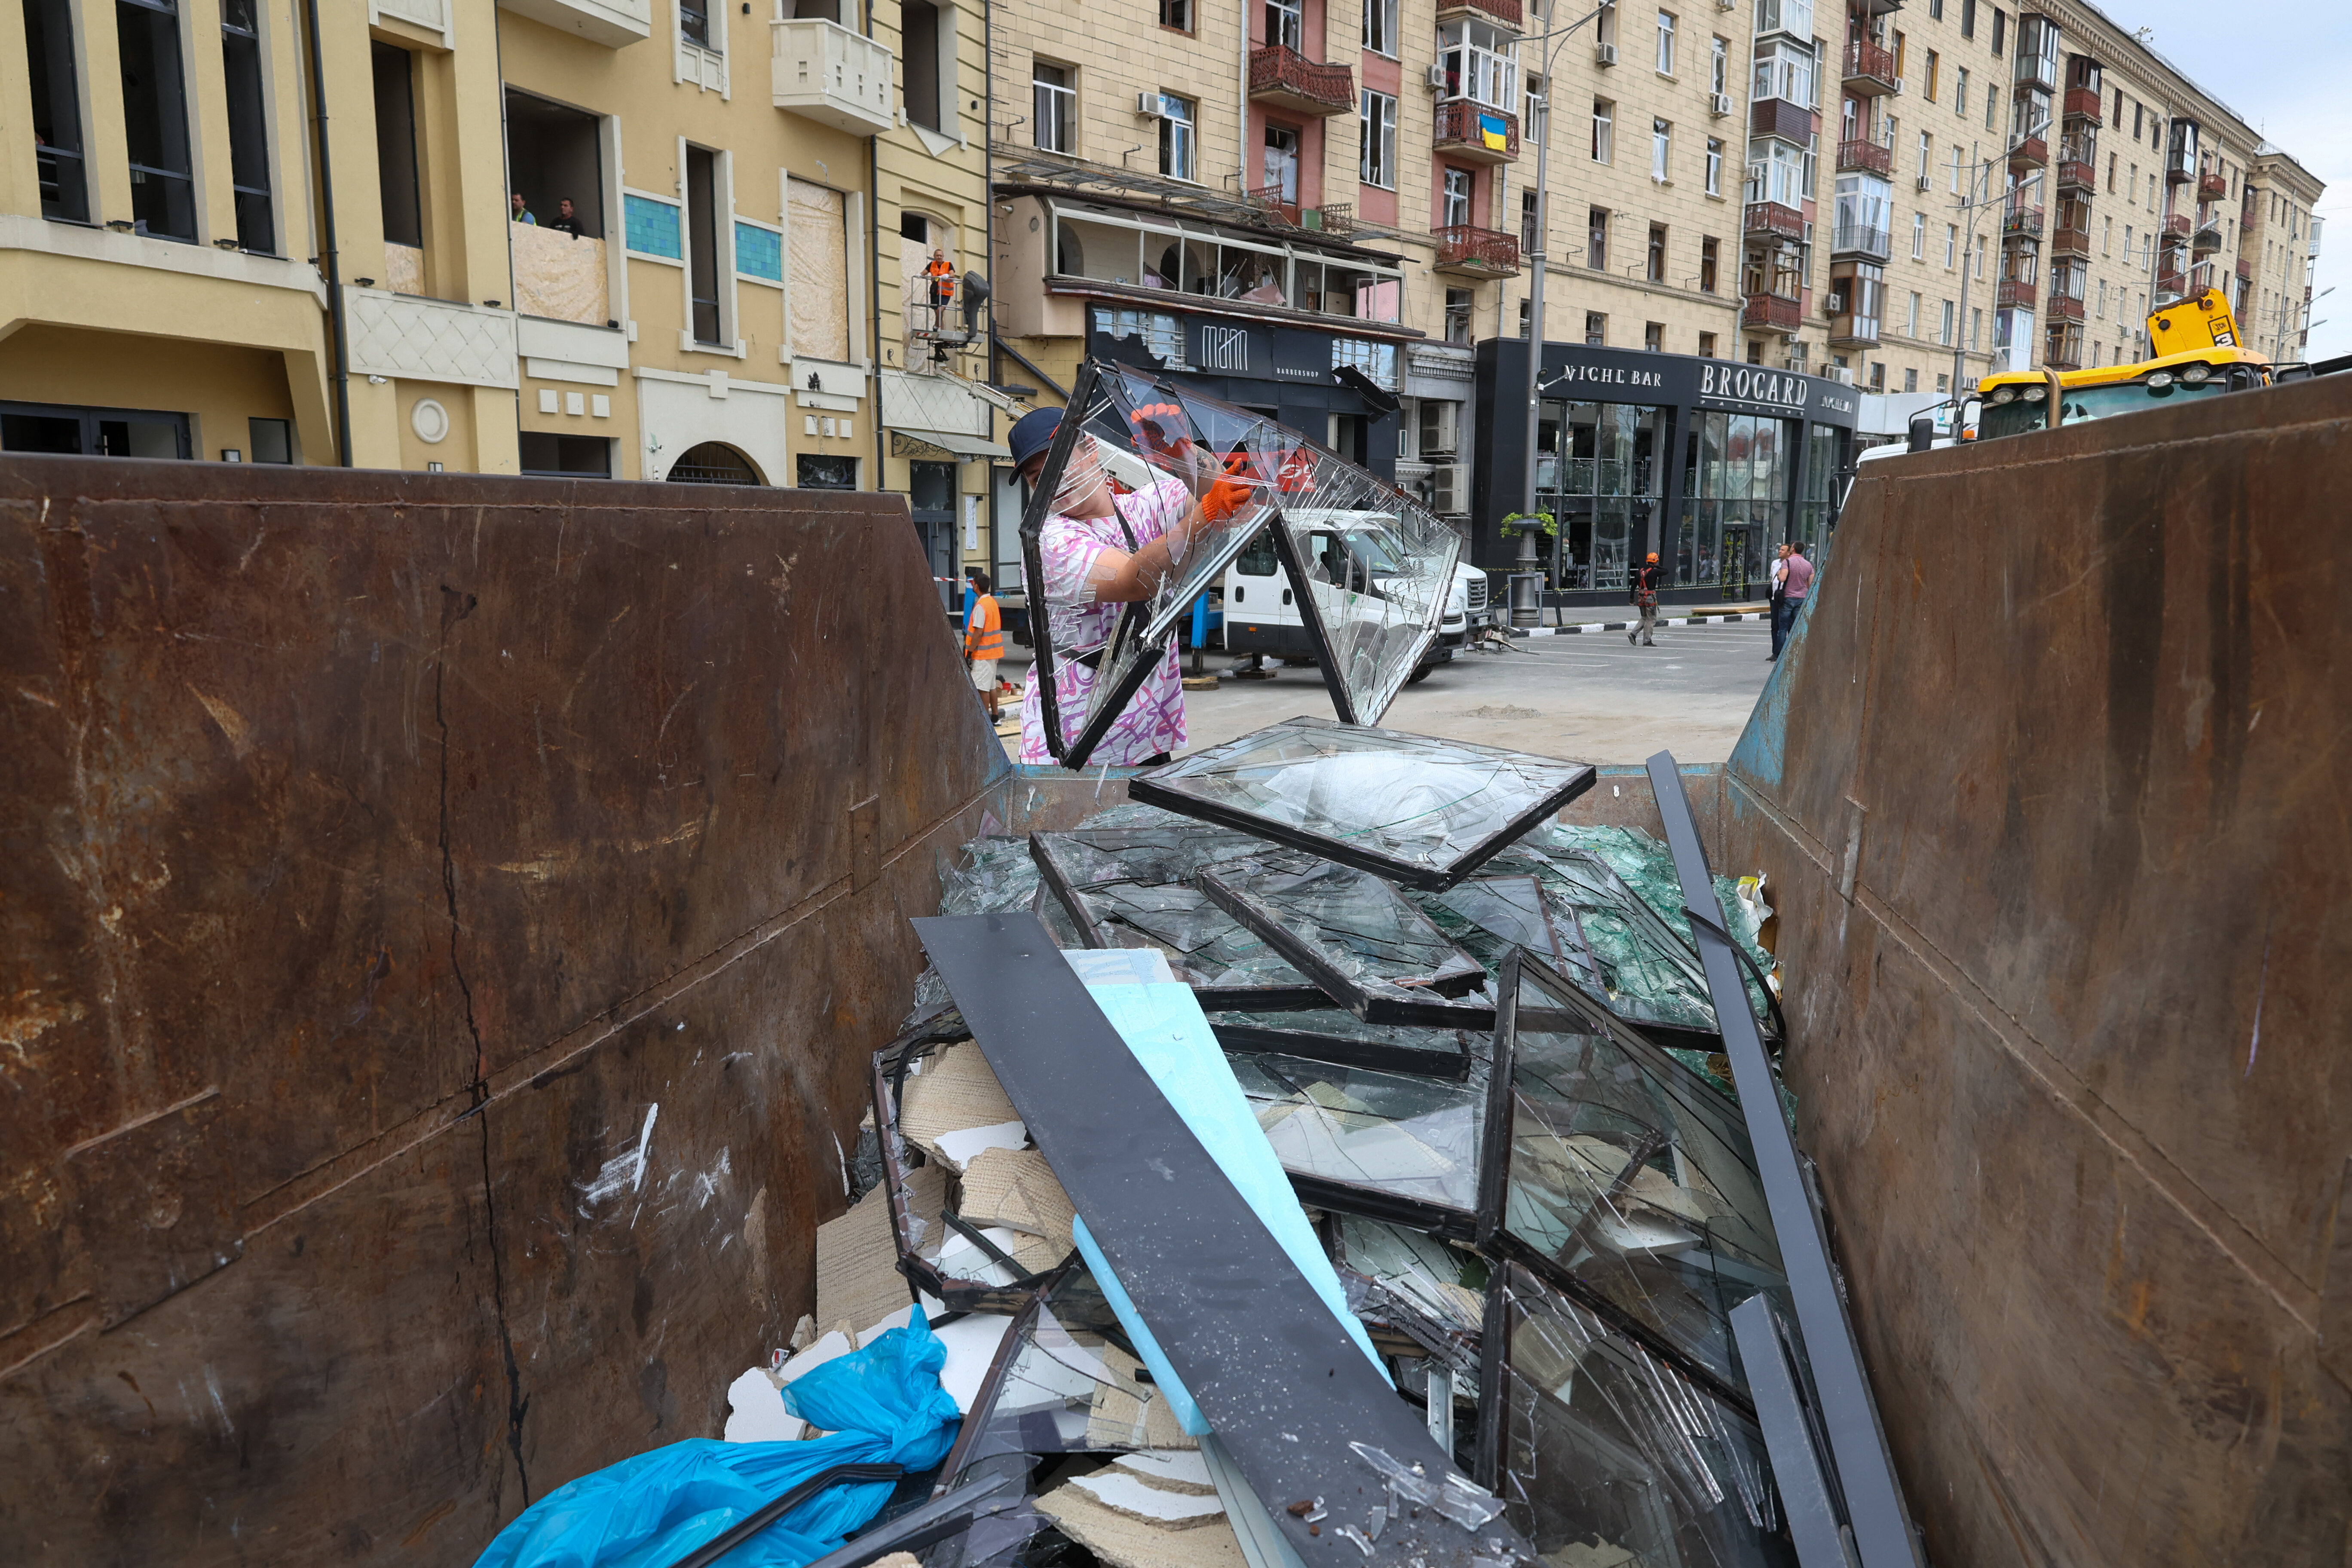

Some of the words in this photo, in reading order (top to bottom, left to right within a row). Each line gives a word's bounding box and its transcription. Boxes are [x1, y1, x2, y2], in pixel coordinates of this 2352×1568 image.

[1277, 368, 1319, 378] BARBERSHOP
[1630, 370, 1661, 387] BAR
[1700, 364, 1807, 406] BROCARD
[1700, 400, 1804, 416] PARFUMS
